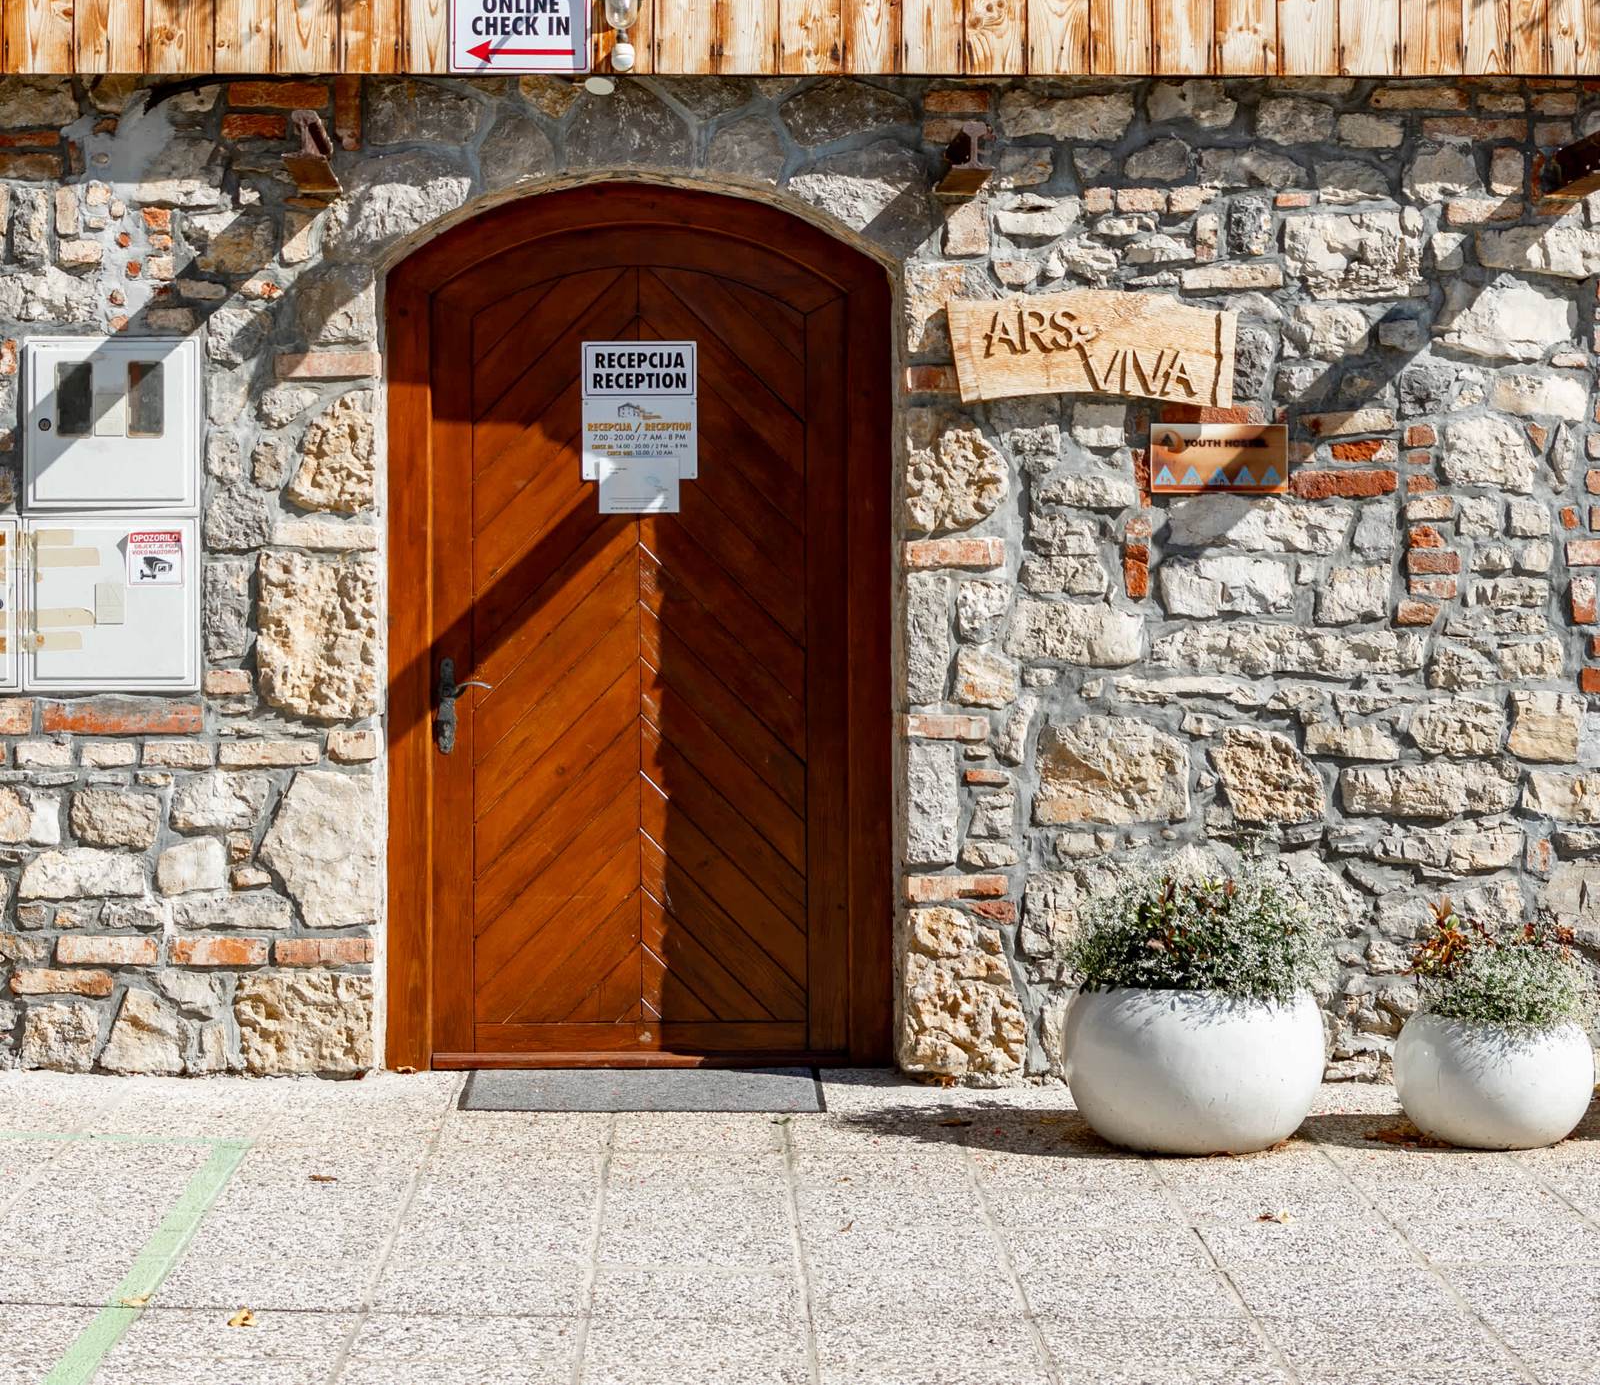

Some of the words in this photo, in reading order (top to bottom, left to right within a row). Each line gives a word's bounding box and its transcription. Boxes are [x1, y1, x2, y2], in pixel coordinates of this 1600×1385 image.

[471, 16, 539, 36] CHECK
[549, 17, 570, 36] IN
[983, 310, 1077, 358] ARS
[595, 352, 685, 369] RECEPCIJA
[1074, 345, 1198, 397] VIVA
[592, 373, 687, 389] RECEPTION
[587, 422, 632, 432] RECEPCIJA
[644, 422, 691, 432] RECEPTION
[1184, 439, 1221, 448] YOUTH
[132, 534, 178, 542] OPOZORILO
